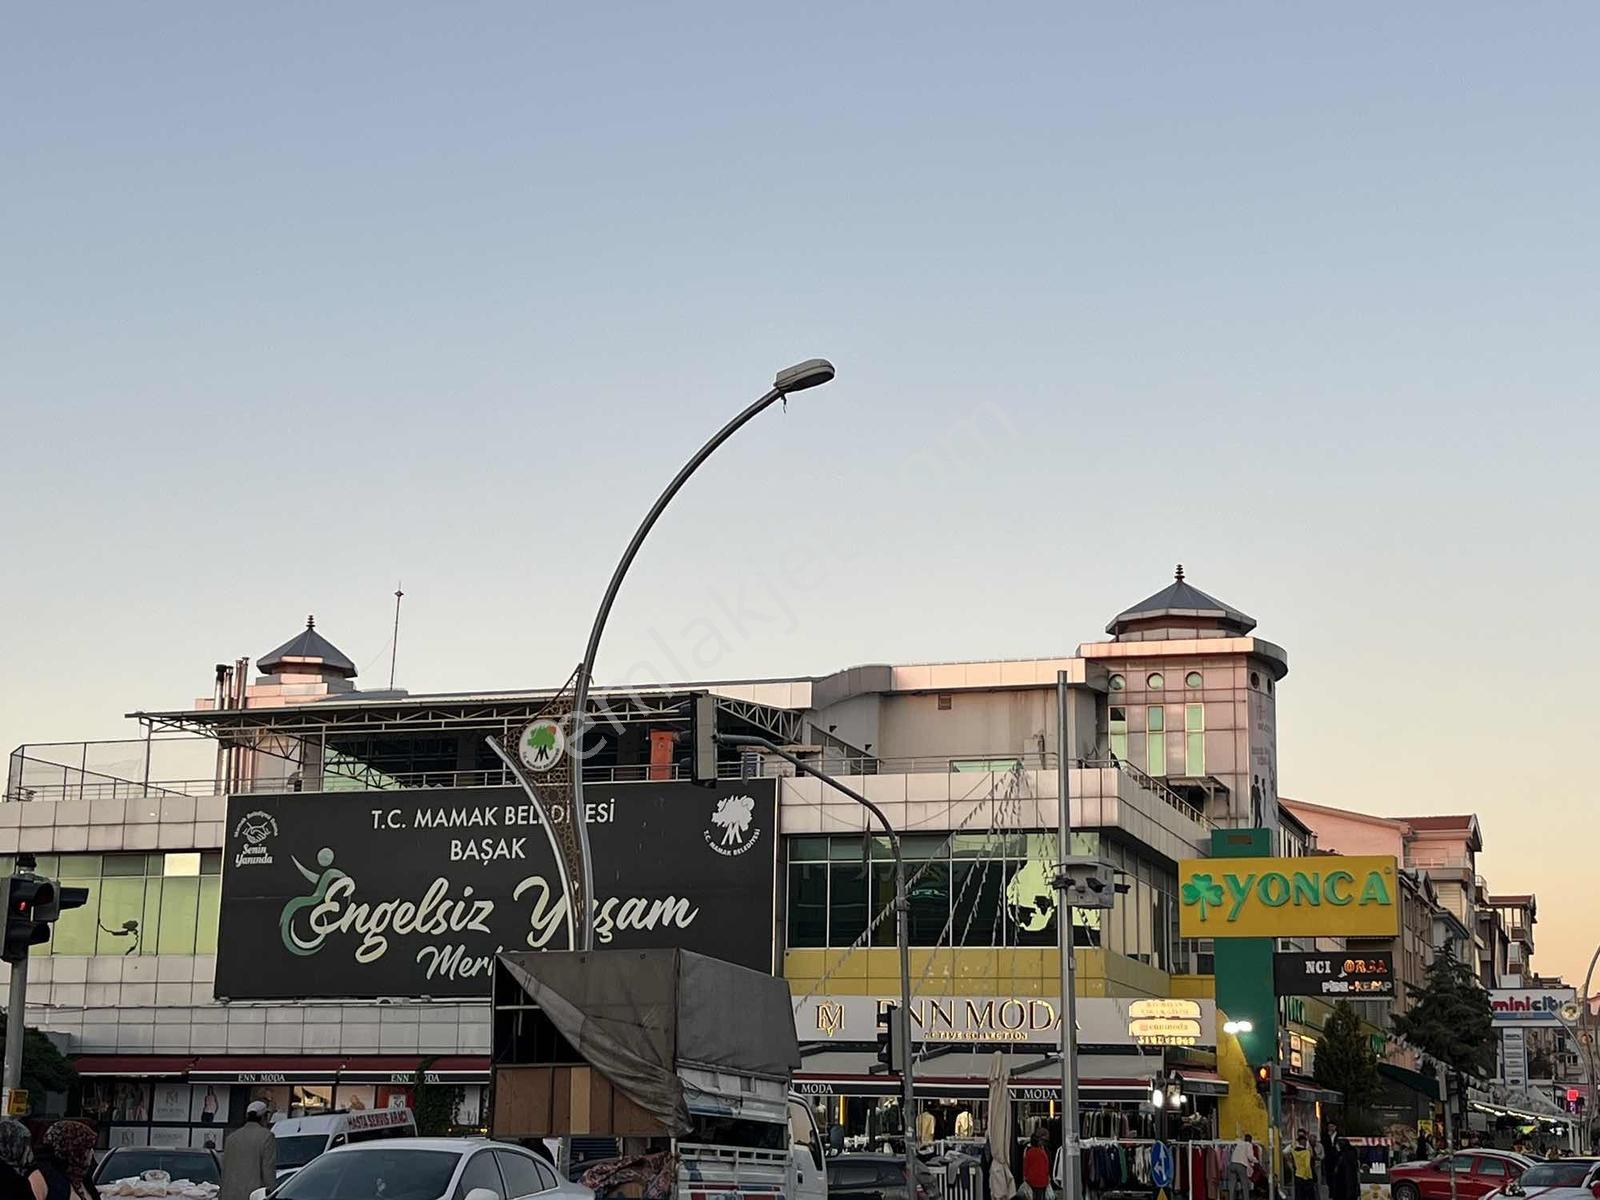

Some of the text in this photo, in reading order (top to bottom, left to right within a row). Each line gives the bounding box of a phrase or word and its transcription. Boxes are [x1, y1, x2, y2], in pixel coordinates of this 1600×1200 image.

[371, 798, 616, 829] T.C. MAMAK BELDİESİ
[242, 843, 267, 855] Senin
[450, 837, 528, 866] BAŞAK
[235, 853, 273, 868] Yanında
[309, 876, 700, 964] Engelsiz Yşam
[238, 1073, 286, 1083] ENN MODA
[391, 1073, 410, 1083] ENN
[800, 1084, 834, 1095] MODA
[1023, 1089, 1059, 1100] MODA
